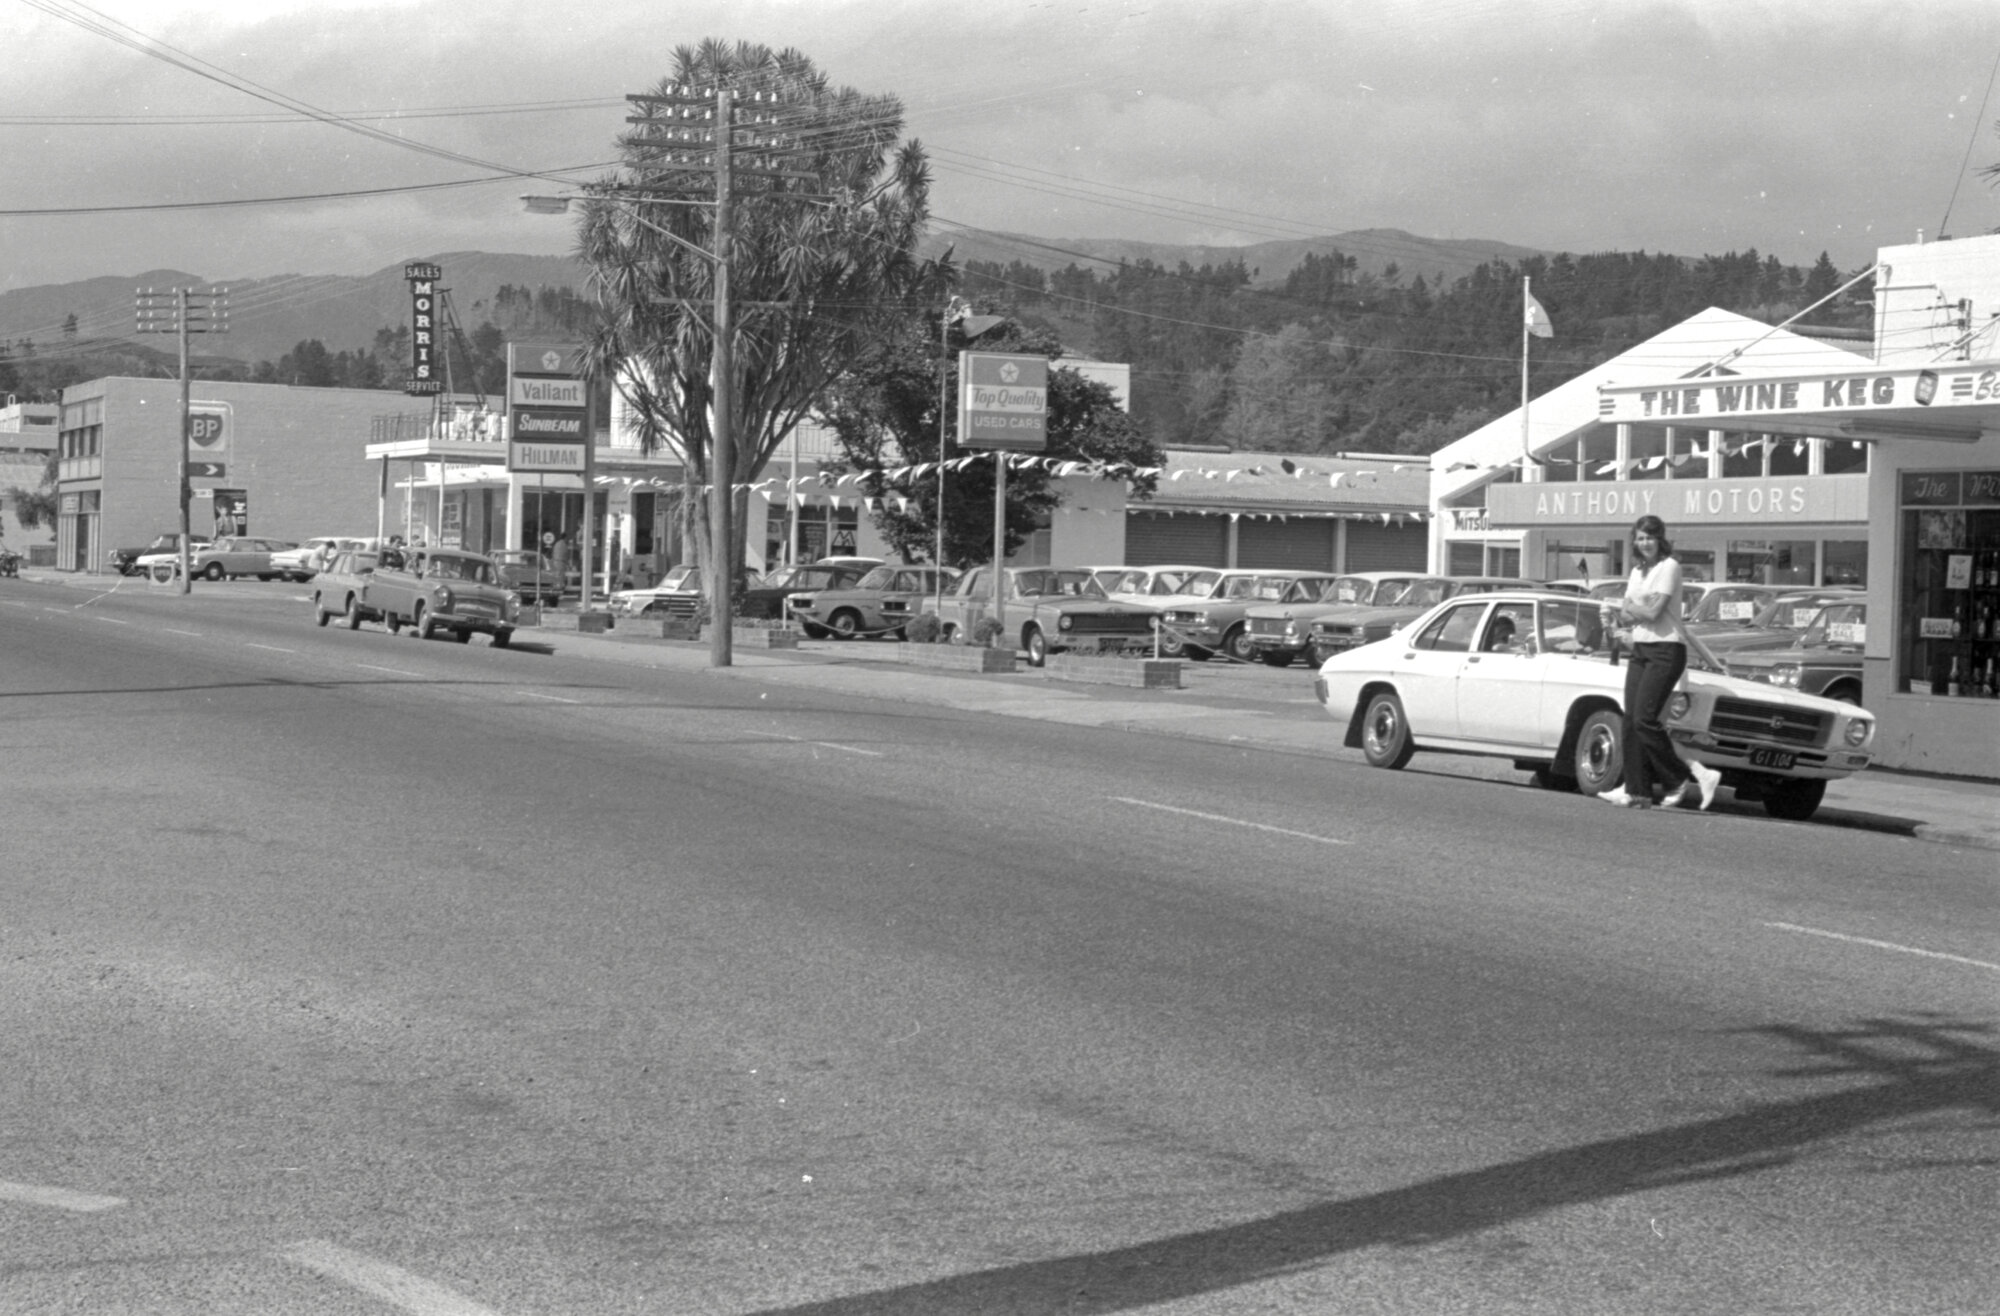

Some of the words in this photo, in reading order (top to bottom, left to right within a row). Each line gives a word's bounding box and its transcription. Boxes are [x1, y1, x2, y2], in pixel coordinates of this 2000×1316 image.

[406, 267, 439, 278] SALES
[415, 281, 433, 378] MORRIS
[406, 381, 440, 392] SERVICE
[522, 383, 578, 401] Valiant
[973, 388, 996, 408] Top
[997, 388, 1044, 412] Quality
[1640, 389, 1700, 417] THE
[1715, 382, 1799, 412] WINE
[1822, 376, 1895, 407] KEG
[192, 419, 219, 438] BP
[519, 414, 580, 432] SUNBEAM
[974, 416, 1006, 428] USED
[1009, 417, 1041, 429] CARS
[521, 446, 577, 465] HILLMAN
[1914, 477, 1948, 498] The
[1536, 490, 1655, 516] ANTHONY
[1685, 487, 1805, 514] MOTORS
